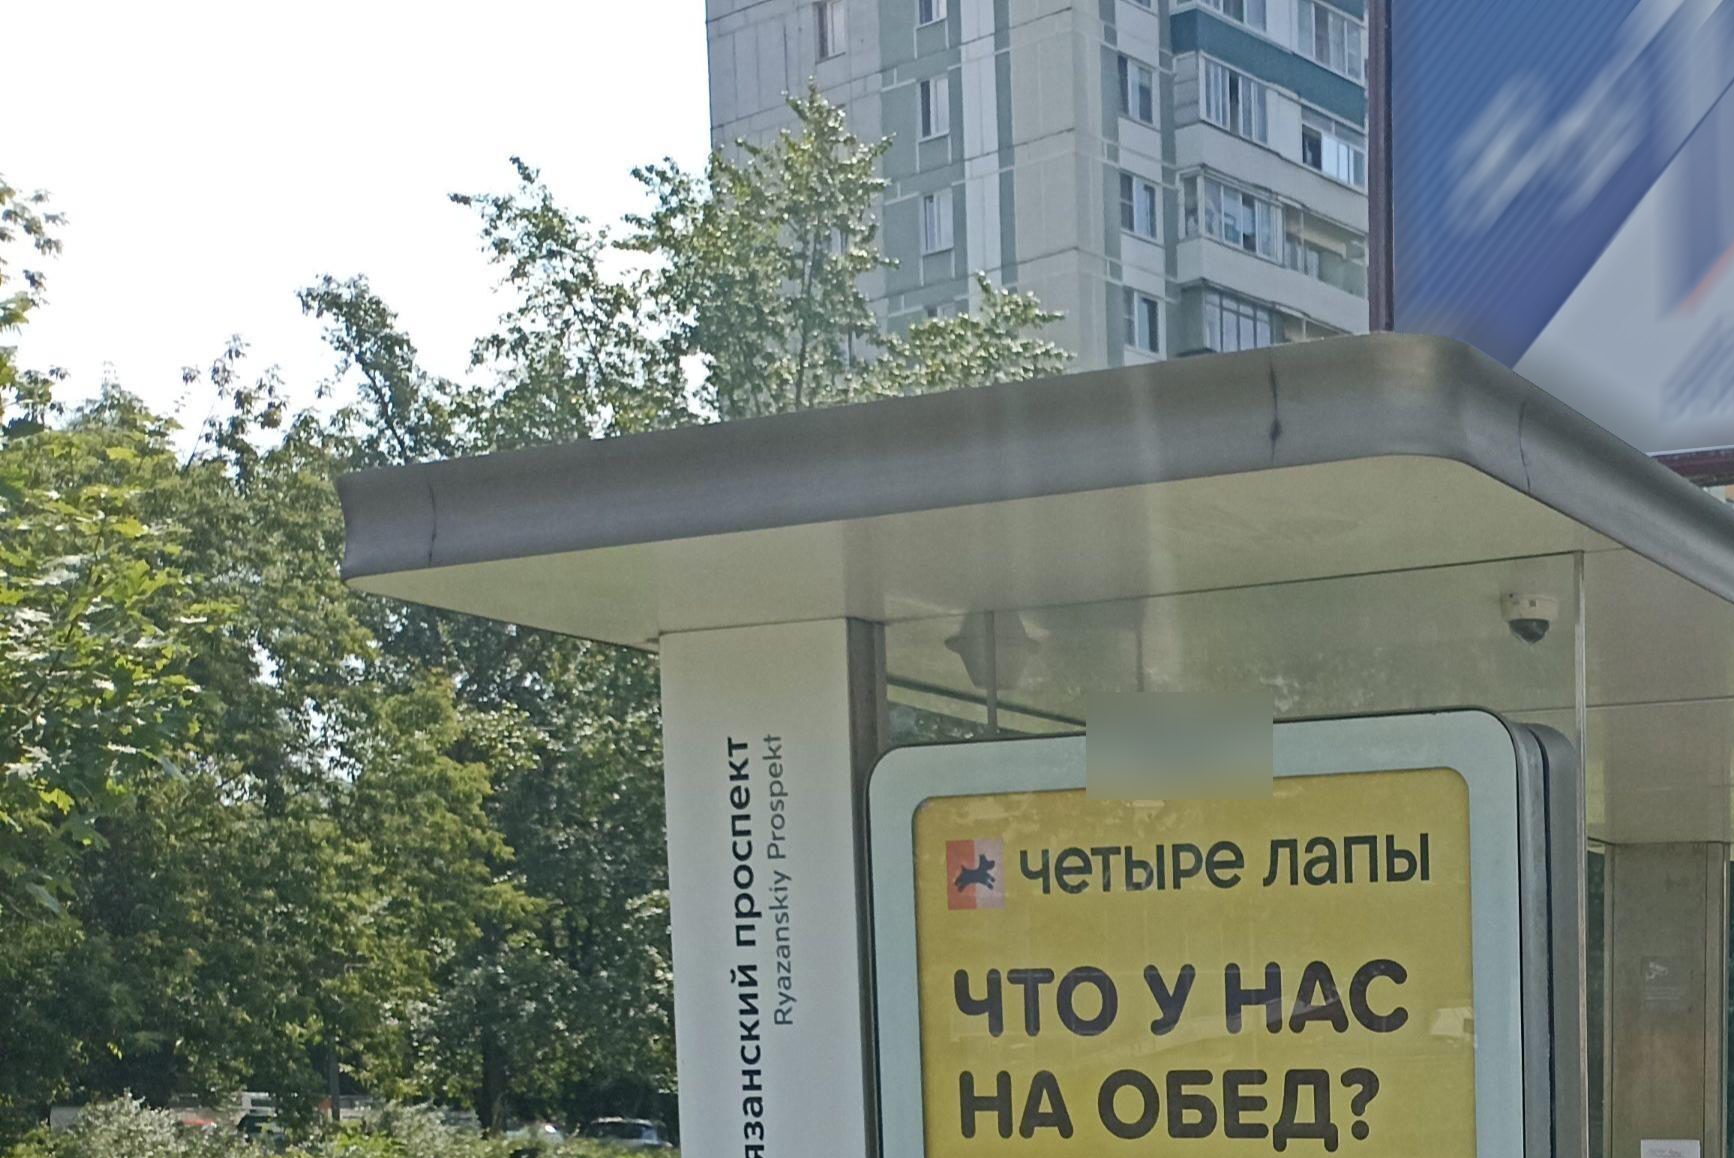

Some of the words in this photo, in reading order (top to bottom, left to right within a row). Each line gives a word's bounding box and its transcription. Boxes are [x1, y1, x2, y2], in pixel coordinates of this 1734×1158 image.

[727, 736, 761, 946] проспект
[762, 733, 790, 860] Prospekt
[1019, 840, 1245, 895] четыре
[1263, 832, 1431, 887] лапы
[768, 871, 794, 1026] Ryazanskiy
[953, 965, 1118, 1037] ЧТО
[1144, 963, 1196, 1036] У
[1225, 958, 1409, 1035] НАС
[959, 1069, 1073, 1139] НА
[1098, 1067, 1381, 1152] ОБЕД?
